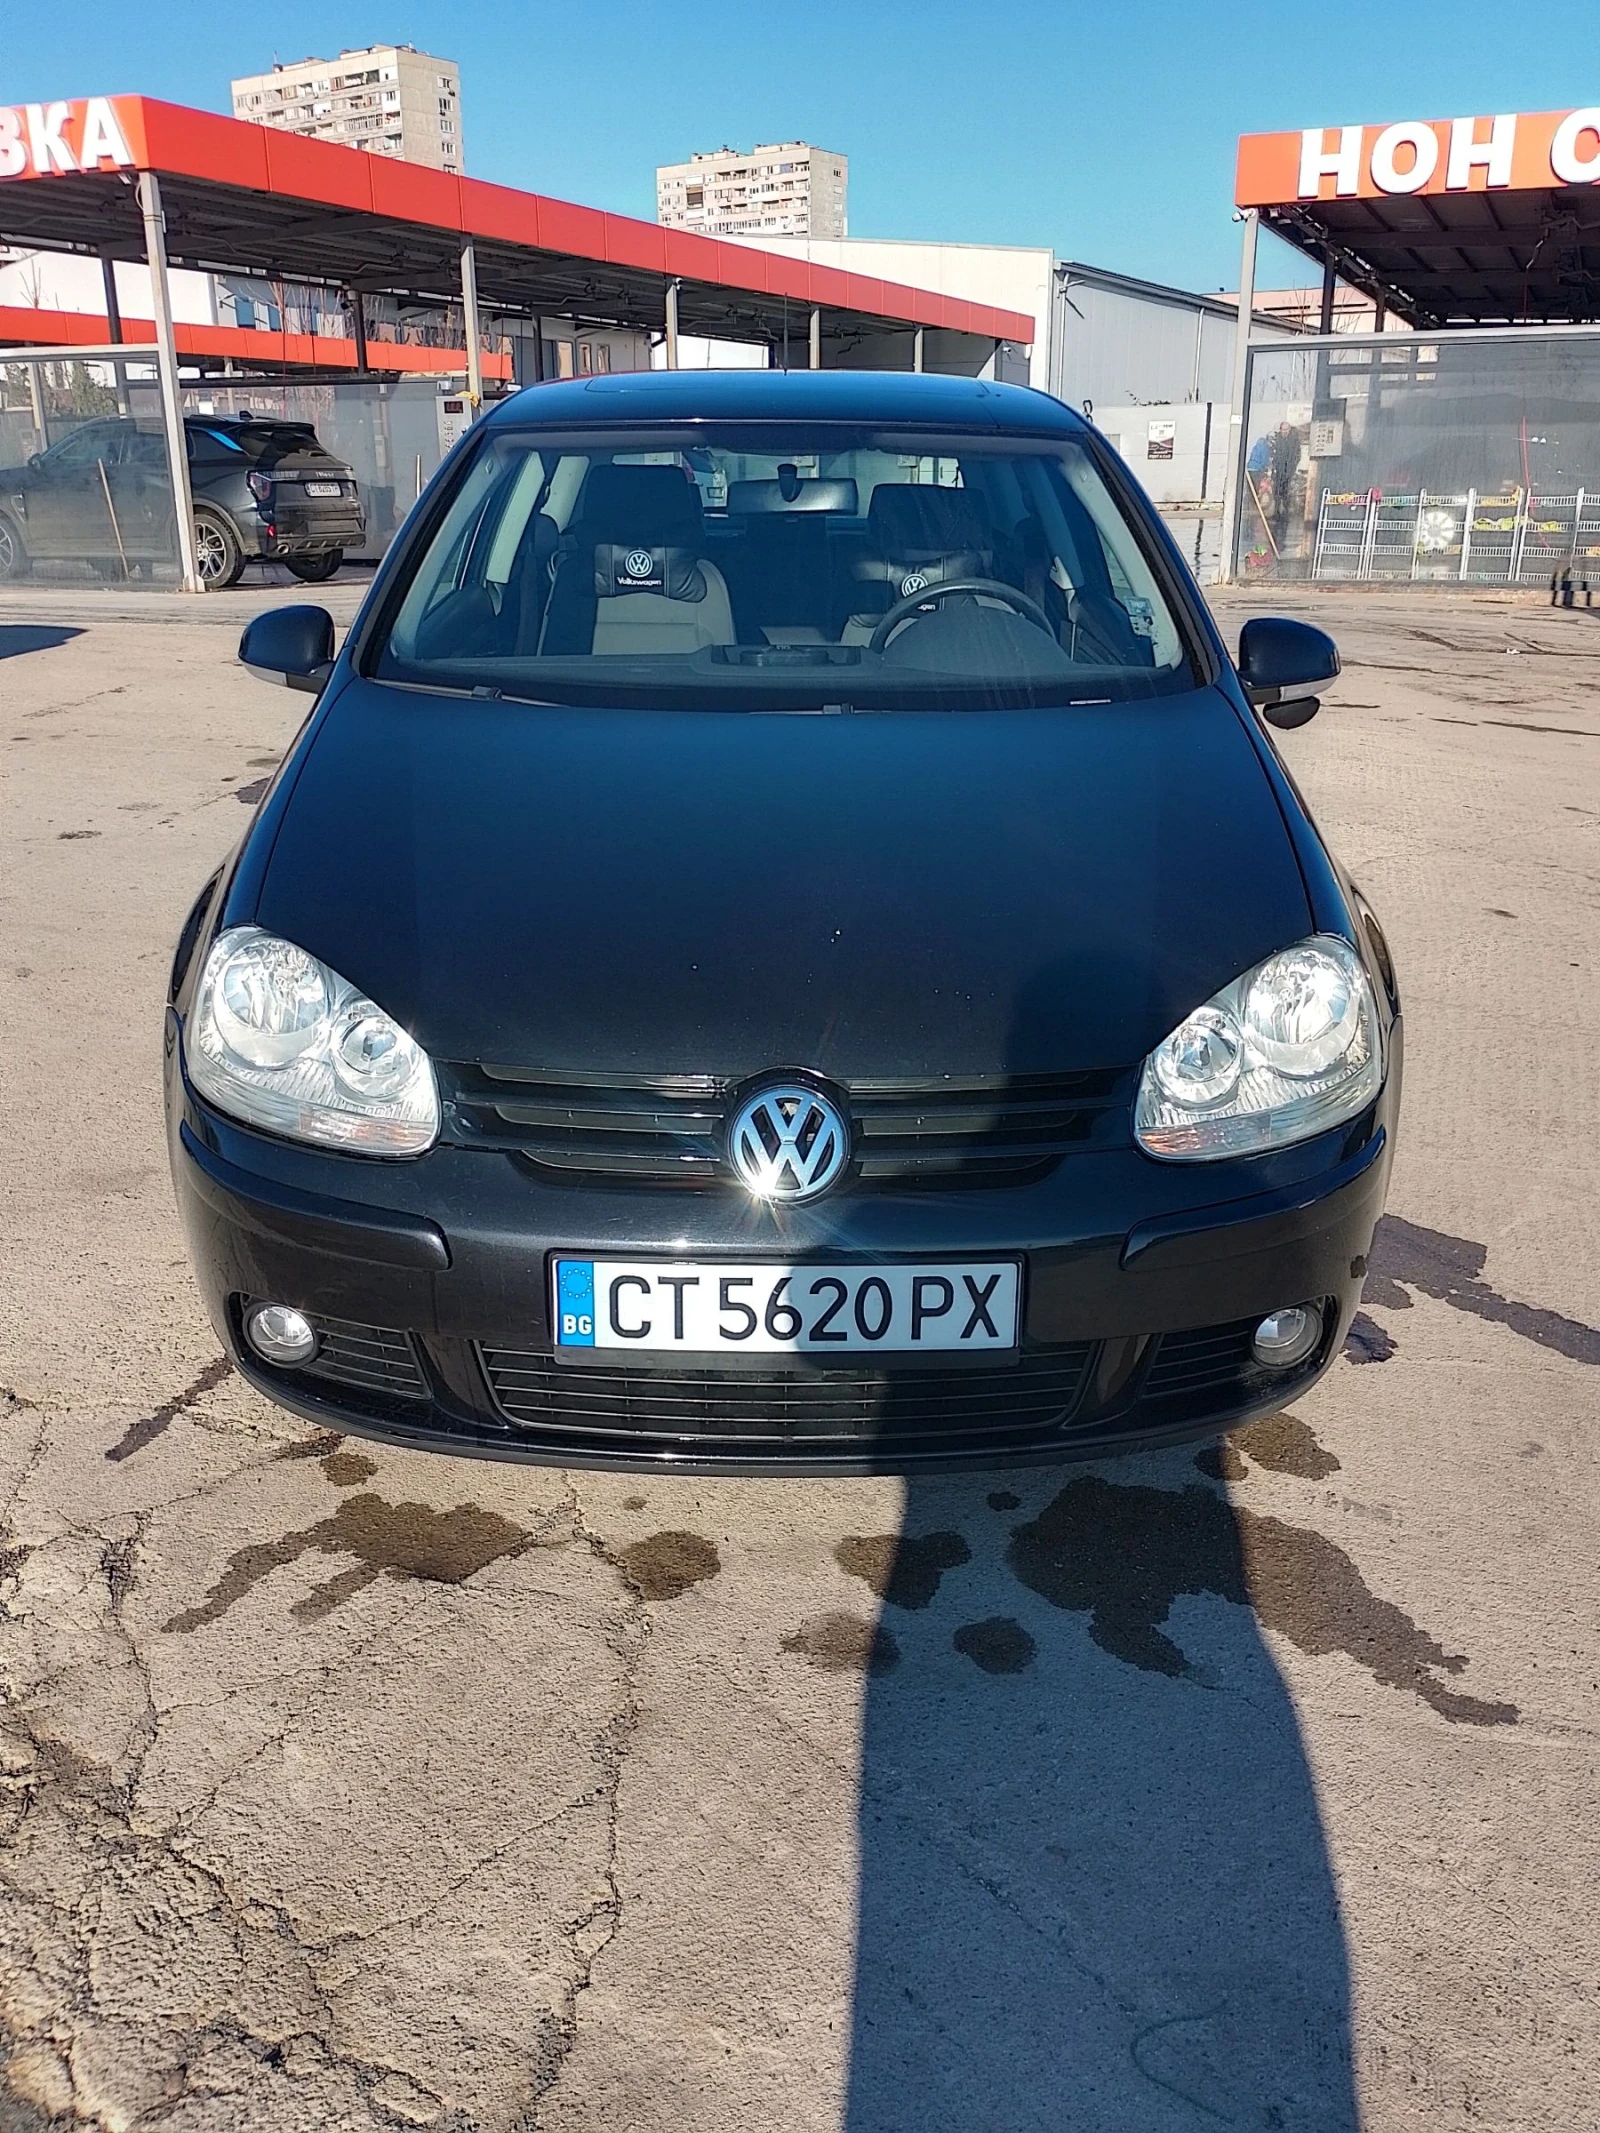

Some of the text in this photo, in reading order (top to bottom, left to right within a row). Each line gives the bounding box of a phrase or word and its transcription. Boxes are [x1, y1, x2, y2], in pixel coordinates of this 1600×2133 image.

[1297, 114, 1517, 199] НОН
[617, 577, 661, 586] Volkswagen
[563, 1314, 592, 1334] BG
[609, 1274, 1001, 1341] CT 5620 PX
